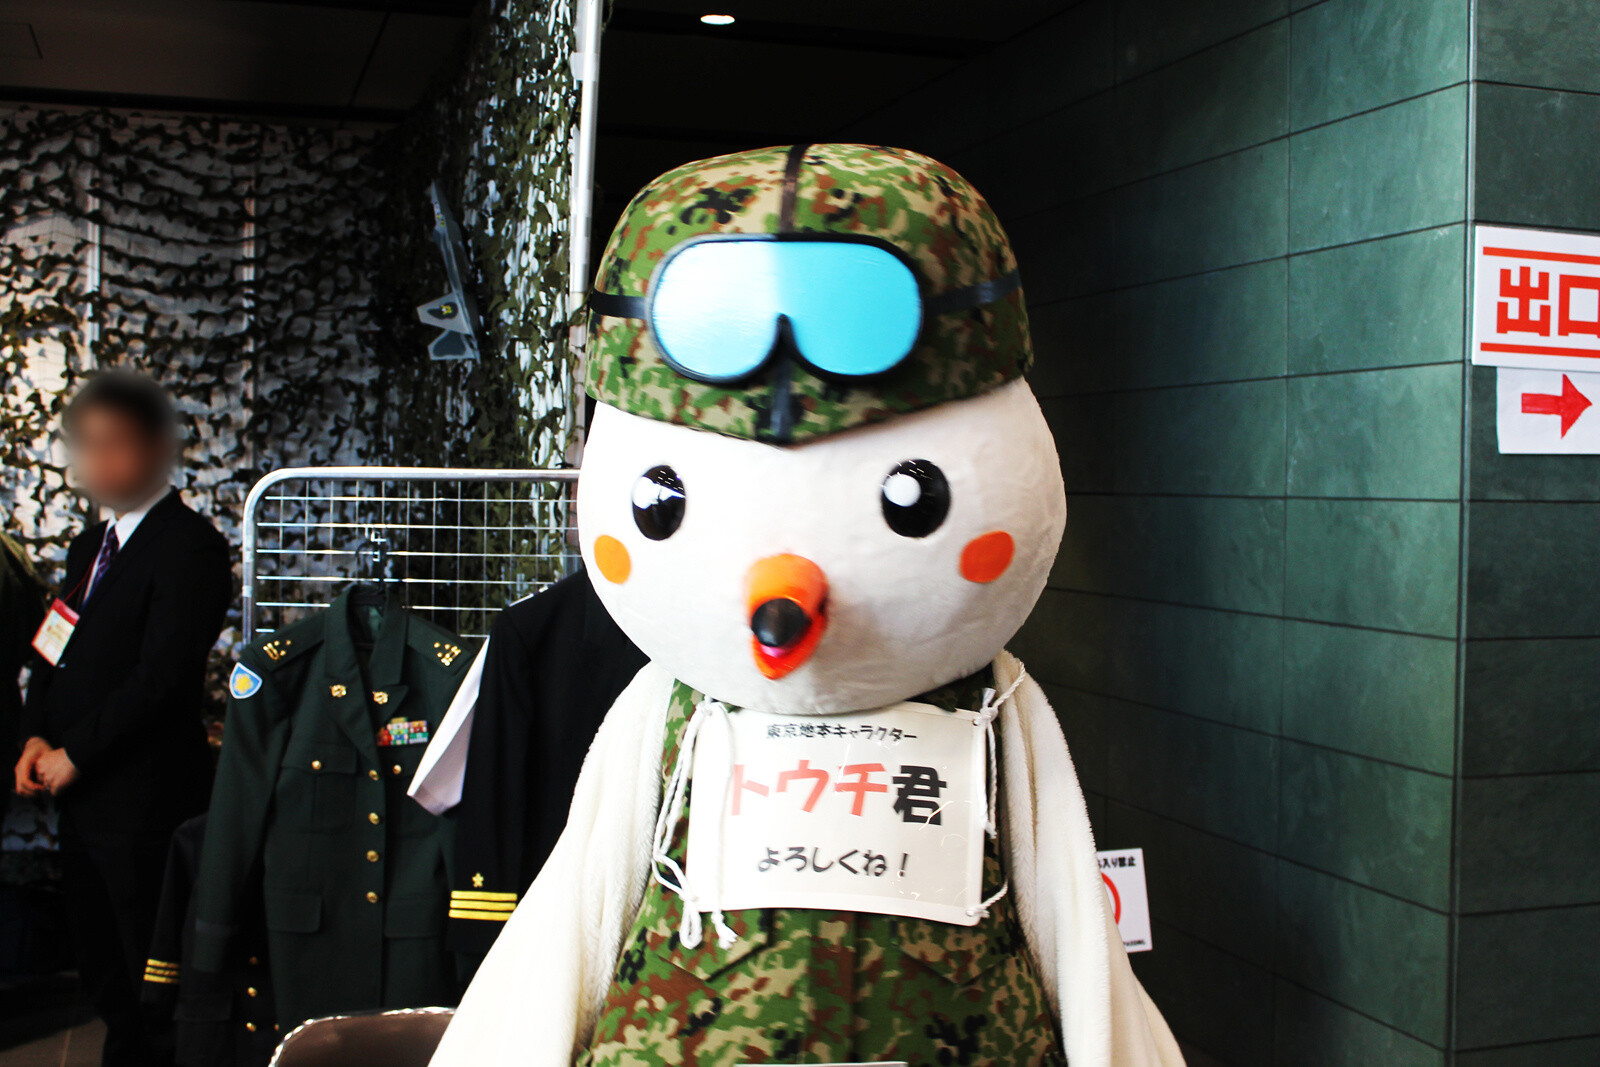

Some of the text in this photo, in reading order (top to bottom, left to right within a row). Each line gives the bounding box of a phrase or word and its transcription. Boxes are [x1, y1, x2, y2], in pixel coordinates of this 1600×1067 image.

[1496, 266, 1600, 338] 出口
[731, 759, 947, 826] トウチ君
